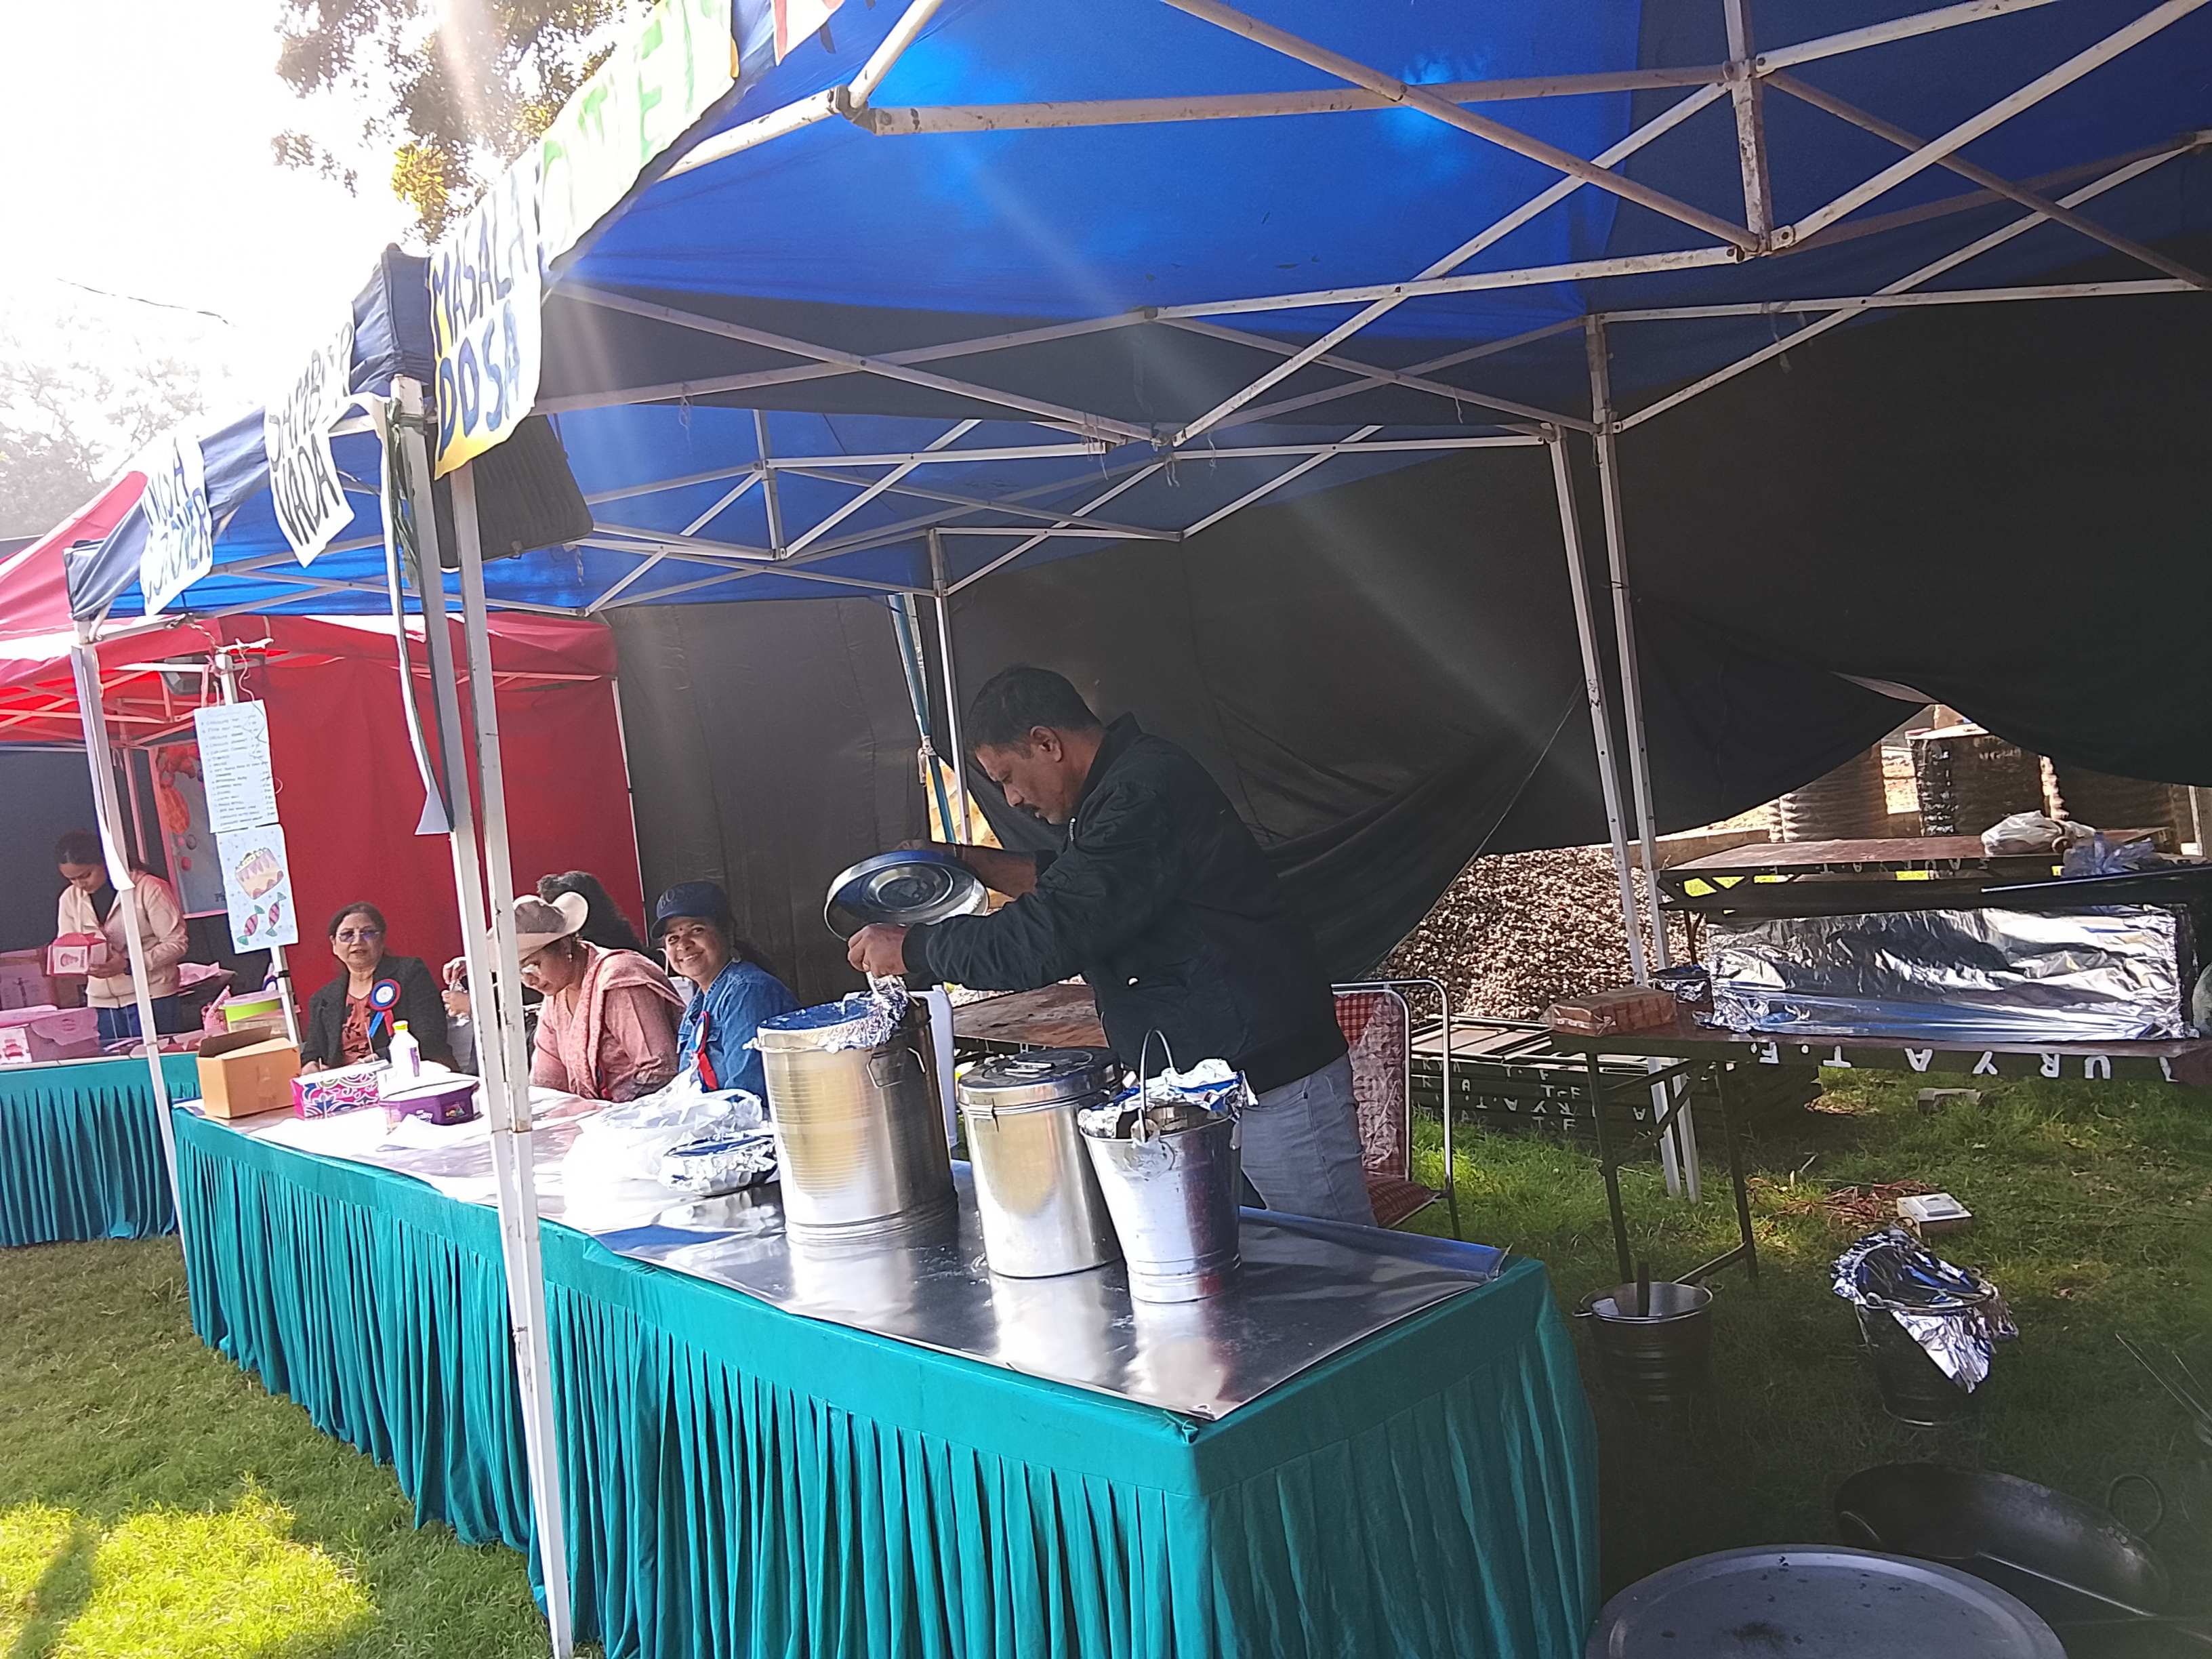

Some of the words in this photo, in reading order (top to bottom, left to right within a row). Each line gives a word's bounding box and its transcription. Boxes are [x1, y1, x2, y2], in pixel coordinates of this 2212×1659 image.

[432, 168, 529, 358] MASALA
[438, 299, 520, 461] DOSA
[274, 432, 340, 546] VADA
